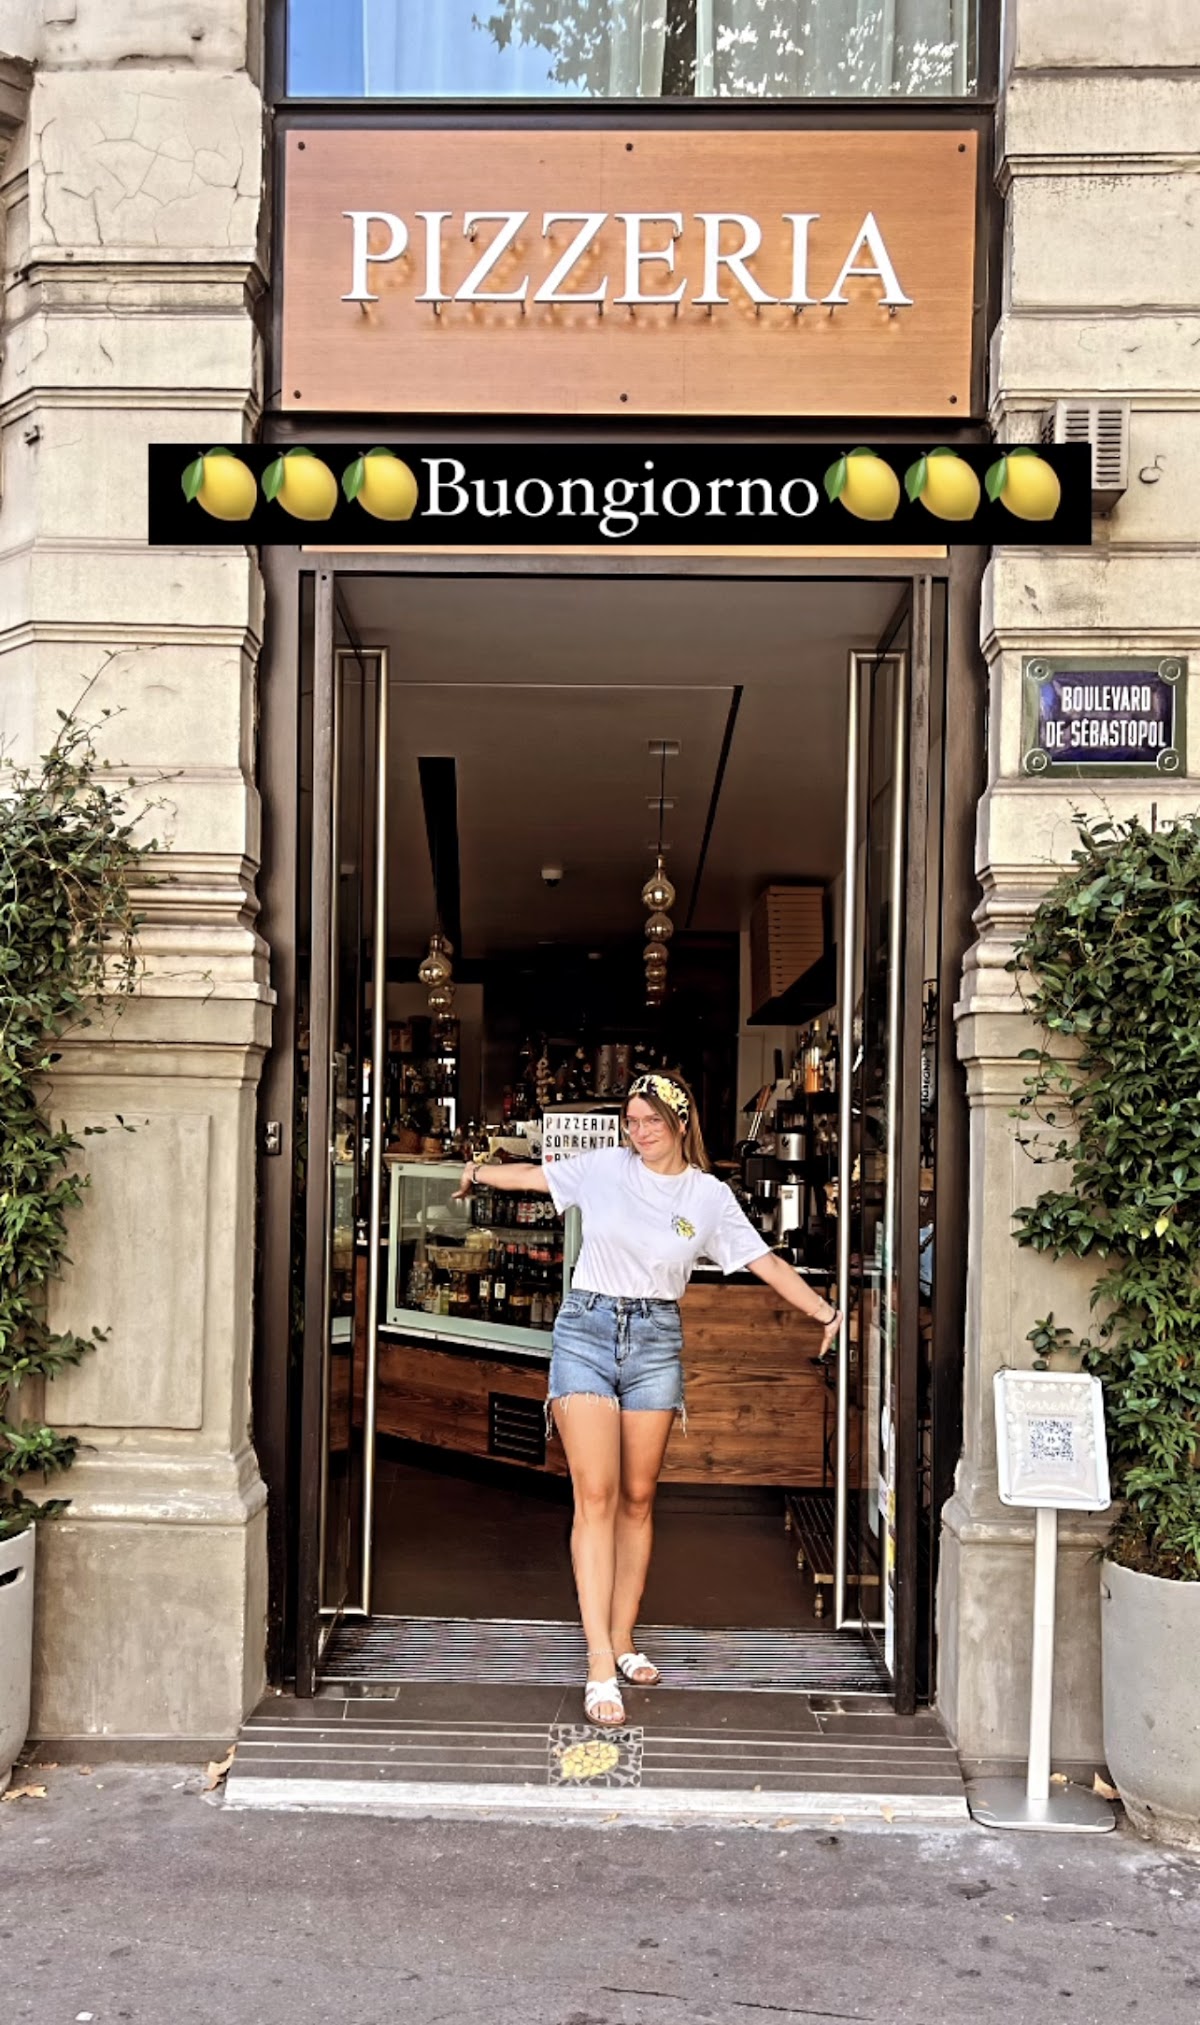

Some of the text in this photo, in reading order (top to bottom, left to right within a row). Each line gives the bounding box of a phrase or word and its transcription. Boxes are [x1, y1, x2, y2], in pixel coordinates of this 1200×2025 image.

[341, 210, 914, 307] PIZZERIA
[1061, 685, 1151, 713] BOULEVARD
[1046, 717, 1167, 748] DE SÉBASTOPOL
[546, 1117, 616, 1132] PIZZERIA
[545, 1135, 615, 1149] SORRENTO
